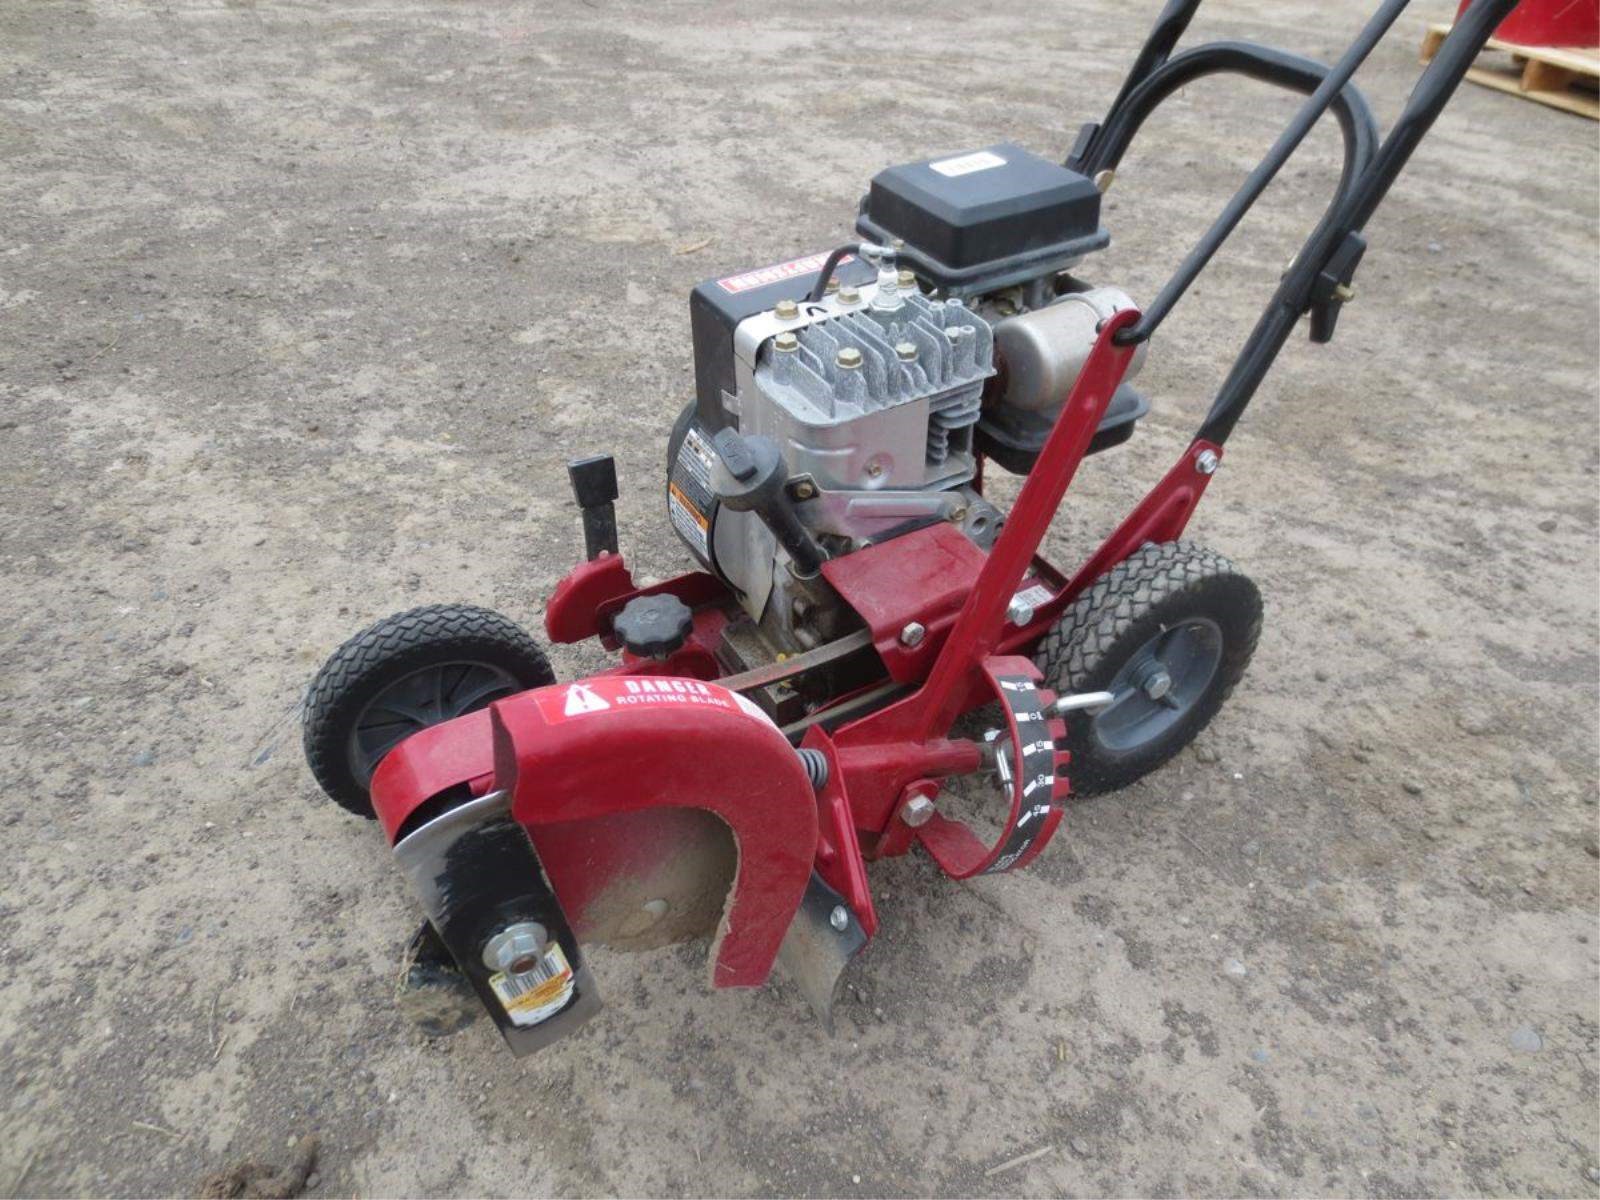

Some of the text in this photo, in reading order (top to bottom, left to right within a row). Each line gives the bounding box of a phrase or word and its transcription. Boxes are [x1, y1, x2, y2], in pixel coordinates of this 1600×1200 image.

[624, 680, 711, 696] DANGER
[616, 694, 731, 707] ROTATING BLADE
